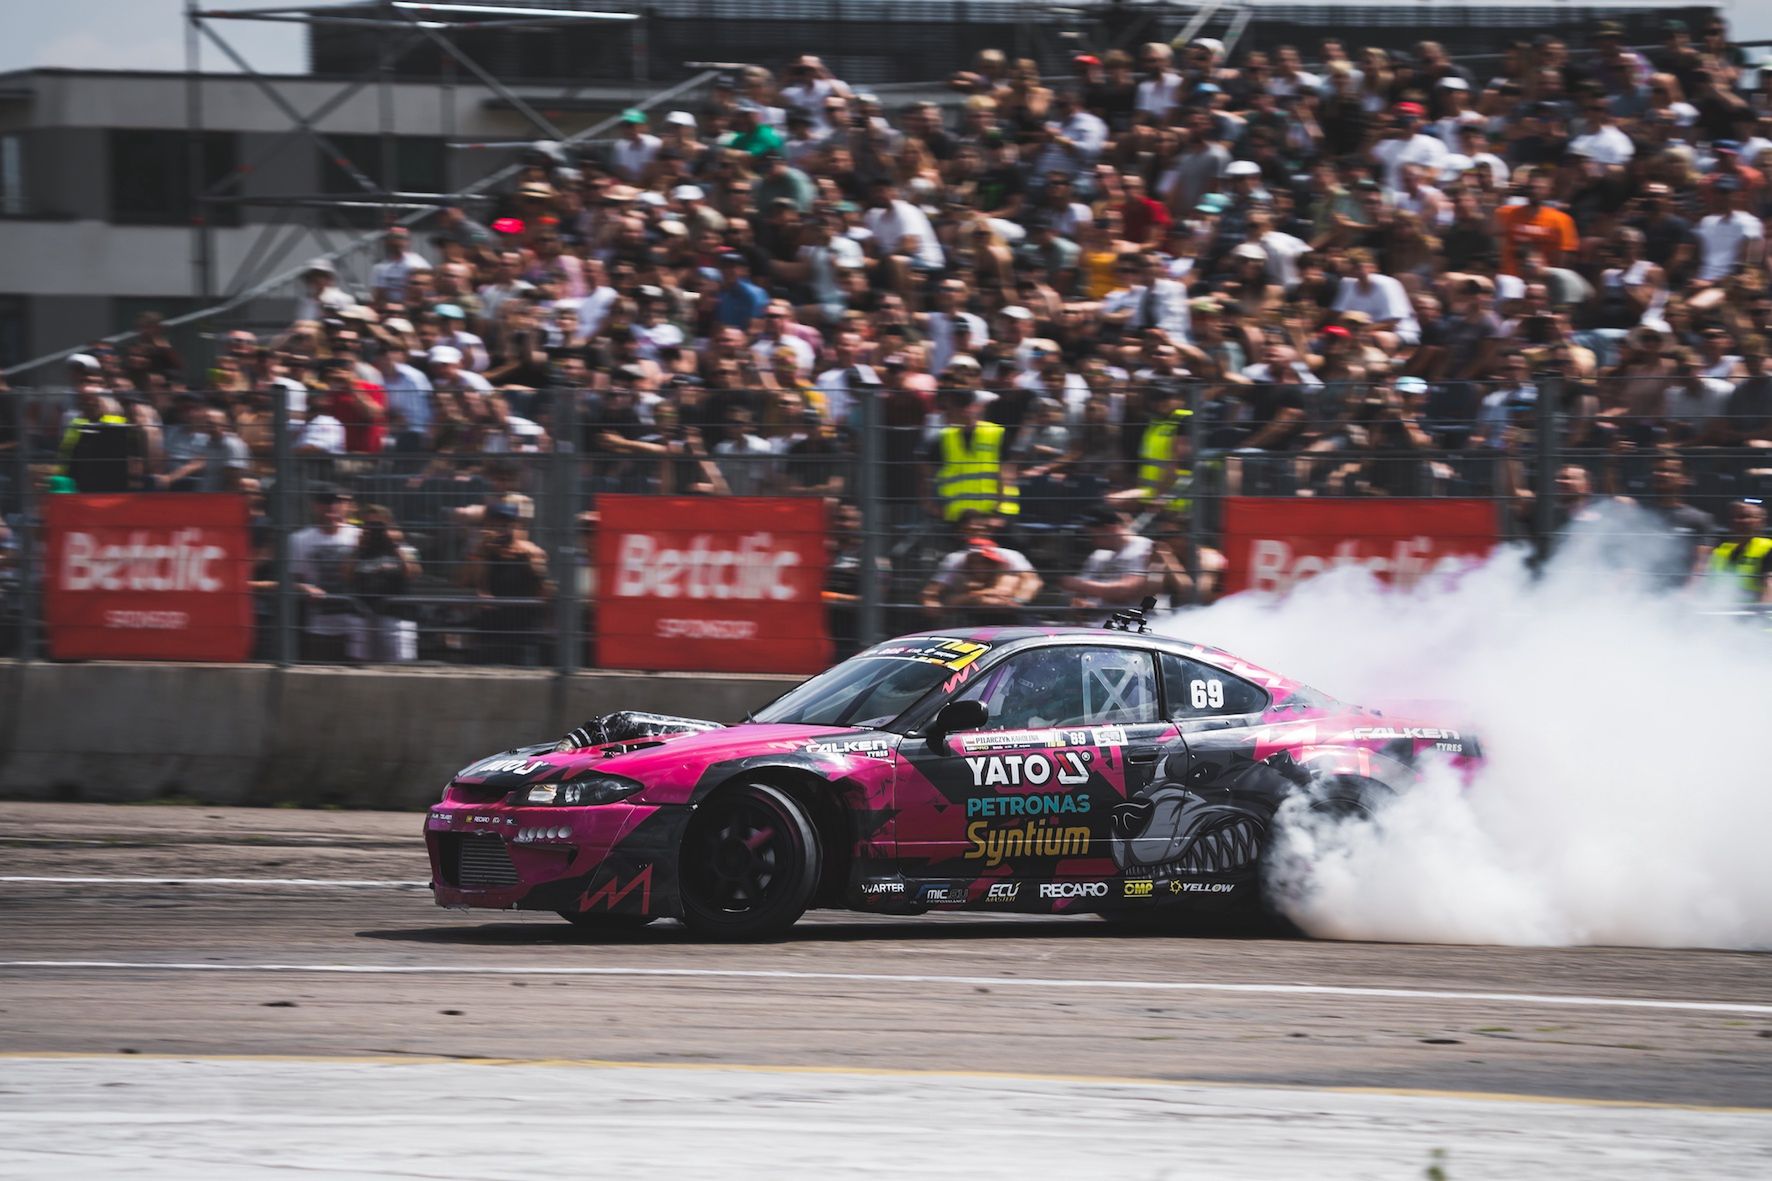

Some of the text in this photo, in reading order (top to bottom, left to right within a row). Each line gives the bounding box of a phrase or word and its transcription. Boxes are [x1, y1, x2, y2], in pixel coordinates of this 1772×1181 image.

[62, 528, 226, 591] Betclic
[615, 532, 801, 599] Betclic
[1190, 679, 1225, 709] 69
[1353, 727, 1460, 739] FALKEN
[806, 740, 888, 753] FALKEN
[1436, 743, 1462, 752] TYRES
[965, 754, 1050, 785] YATO
[967, 794, 1091, 816] PETRONAS
[964, 818, 1091, 867] Syntium
[988, 882, 1022, 897] ECU
[1039, 882, 1109, 898] RECARO
[1124, 883, 1153, 894] OMP
[1182, 883, 1234, 893] YELLOW
